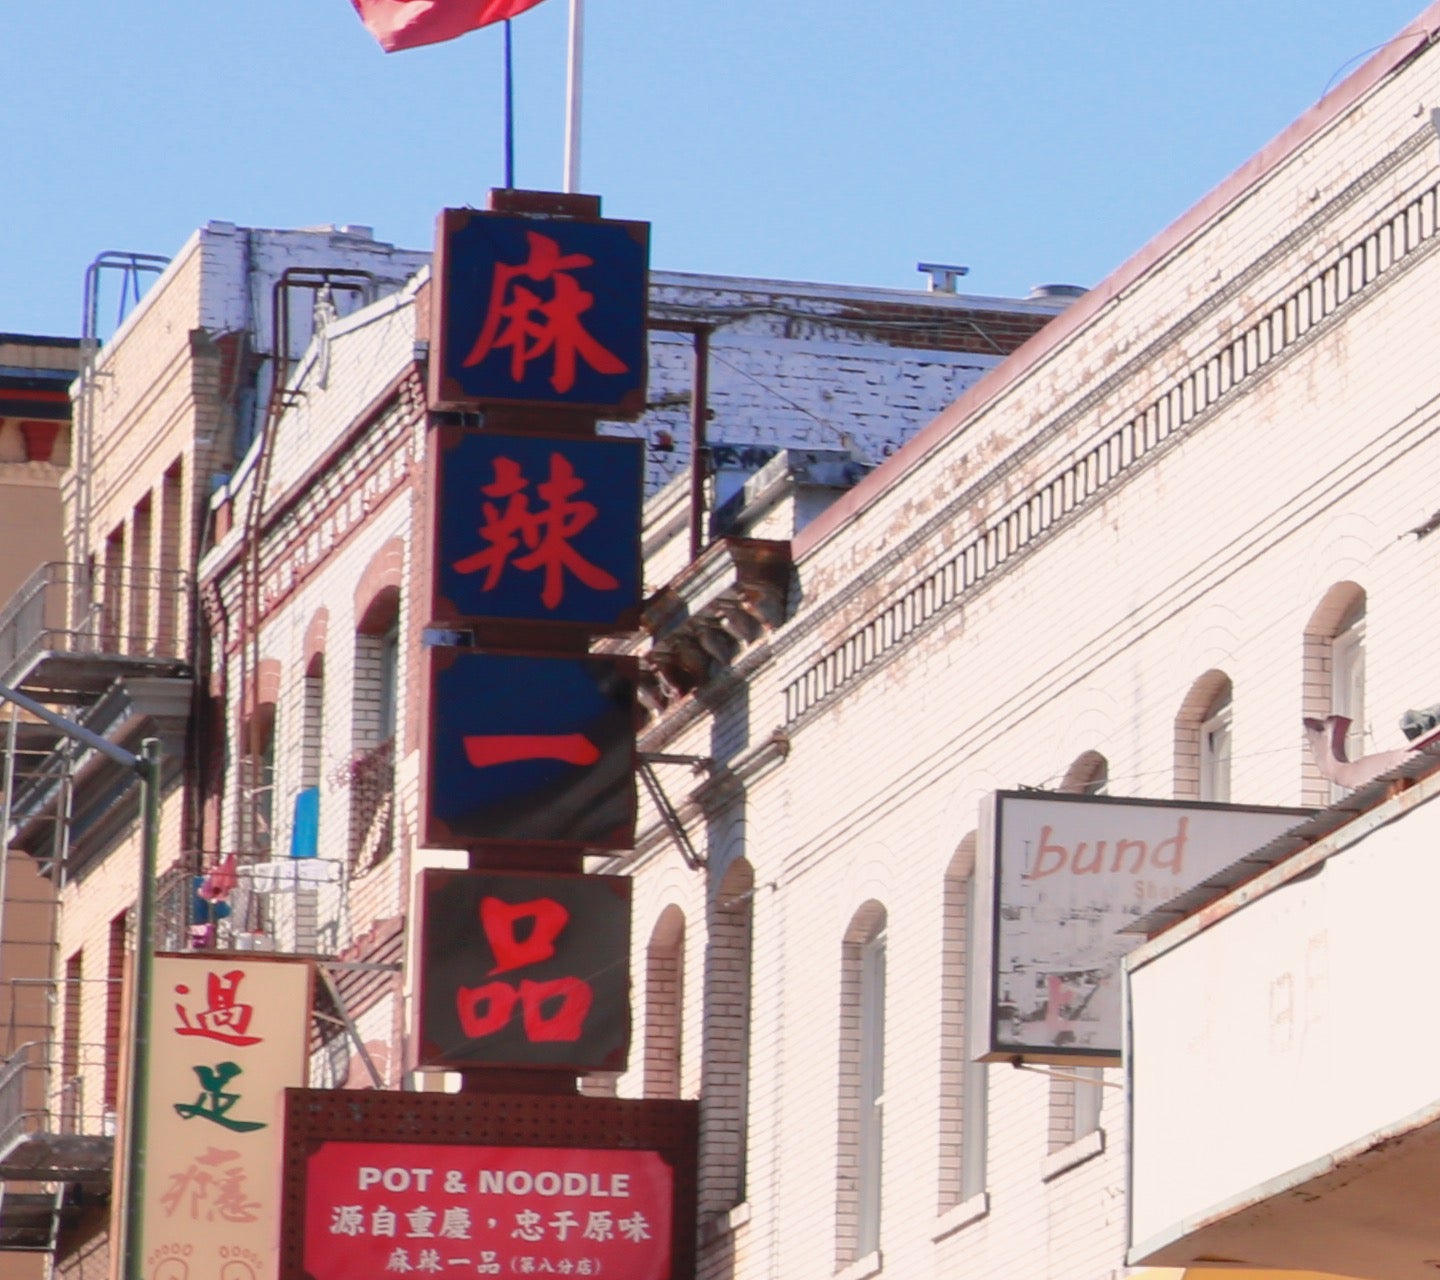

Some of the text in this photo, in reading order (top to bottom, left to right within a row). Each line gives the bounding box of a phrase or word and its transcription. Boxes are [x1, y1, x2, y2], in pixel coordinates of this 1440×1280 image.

[452, 230, 629, 1044] 麻辣一品
[1024, 816, 1190, 882] bund
[358, 1166, 631, 1198] POT & NOODLE
